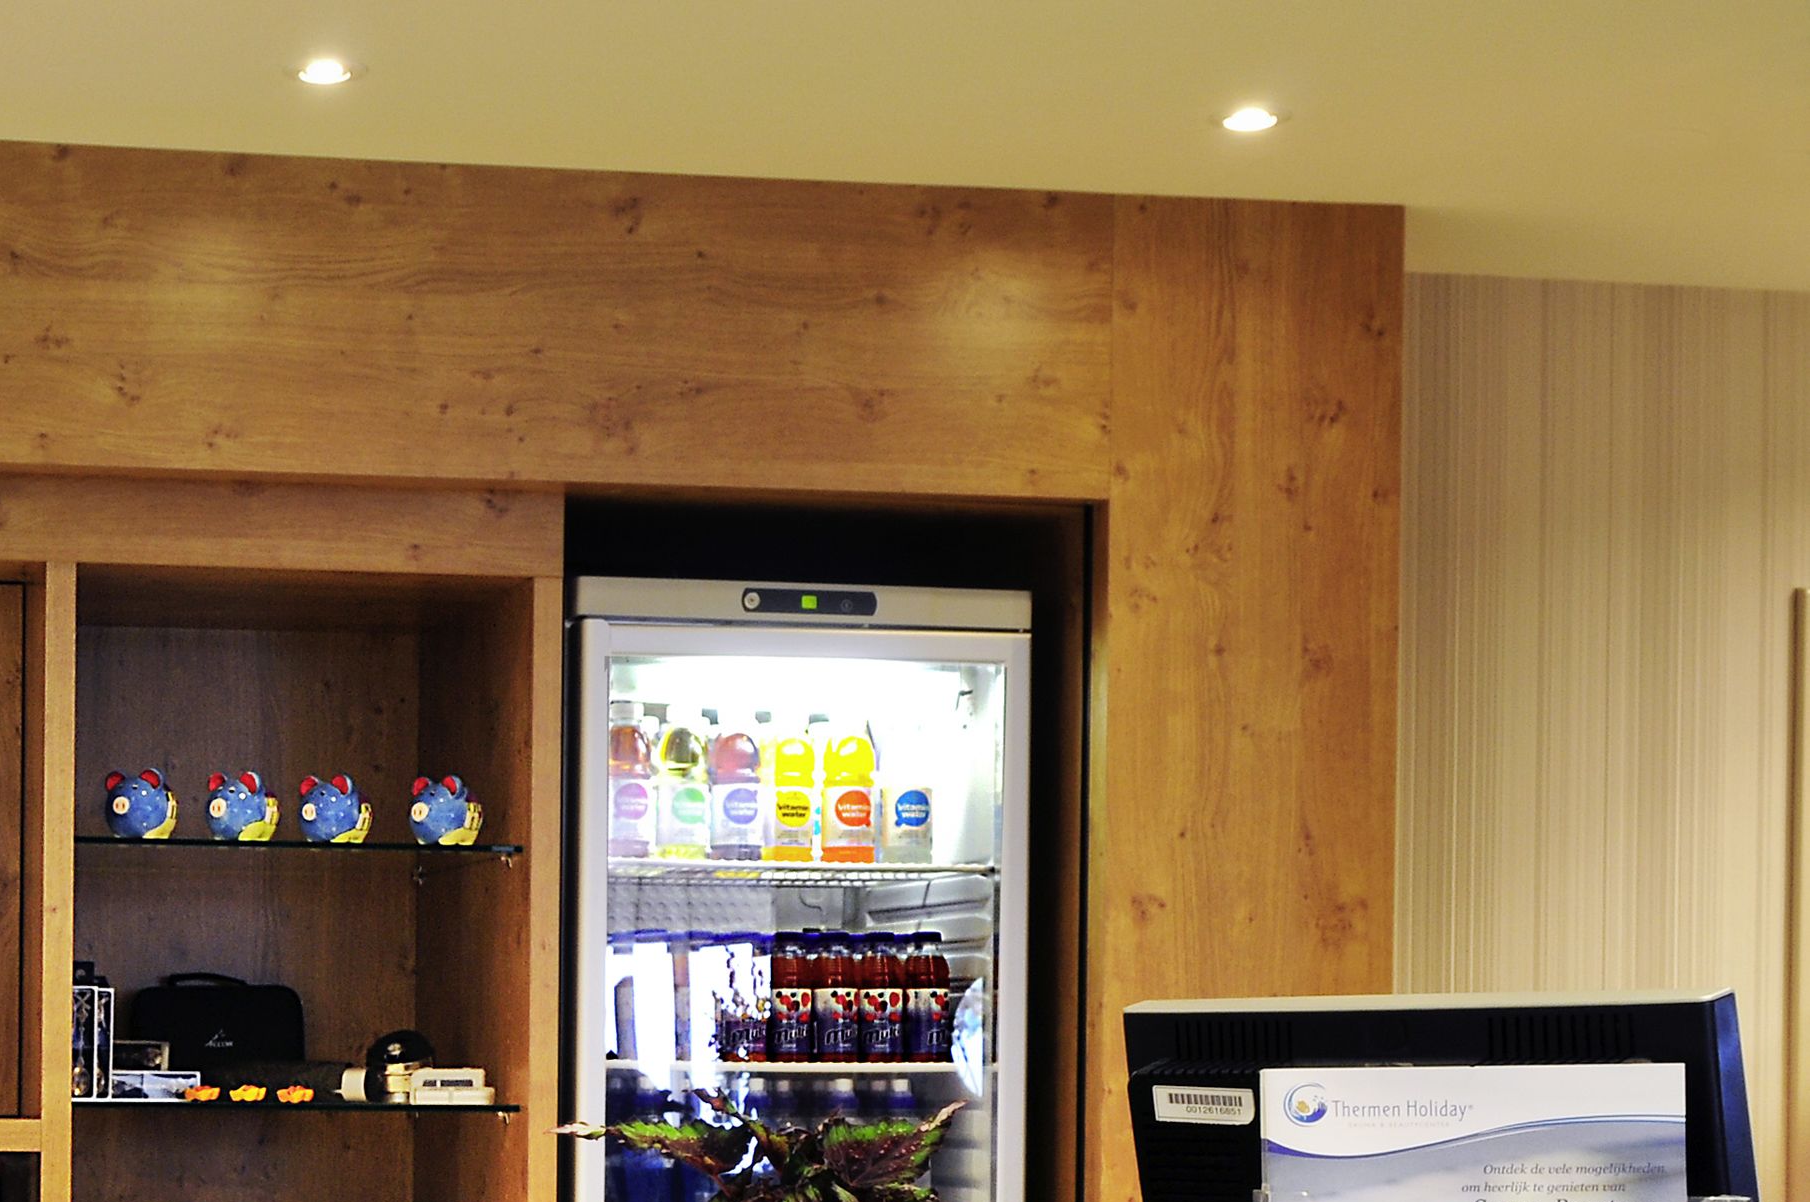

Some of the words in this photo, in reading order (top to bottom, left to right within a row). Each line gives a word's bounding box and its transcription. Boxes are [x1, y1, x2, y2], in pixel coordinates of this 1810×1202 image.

[777, 803, 809, 812] vitamin
[1332, 1100, 1401, 1118] Thermen
[1483, 1163, 1528, 1175] Ontdek
[1530, 1163, 1544, 1175] de
[1548, 1164, 1572, 1175] vele
[1576, 1162, 1666, 1176] mogelijkheden
[1461, 1184, 1481, 1193] om
[1483, 1181, 1530, 1195] heerlijk
[1533, 1182, 1544, 1193] te
[1546, 1180, 1600, 1195] genieten
[1602, 1183, 1626, 1193] van
